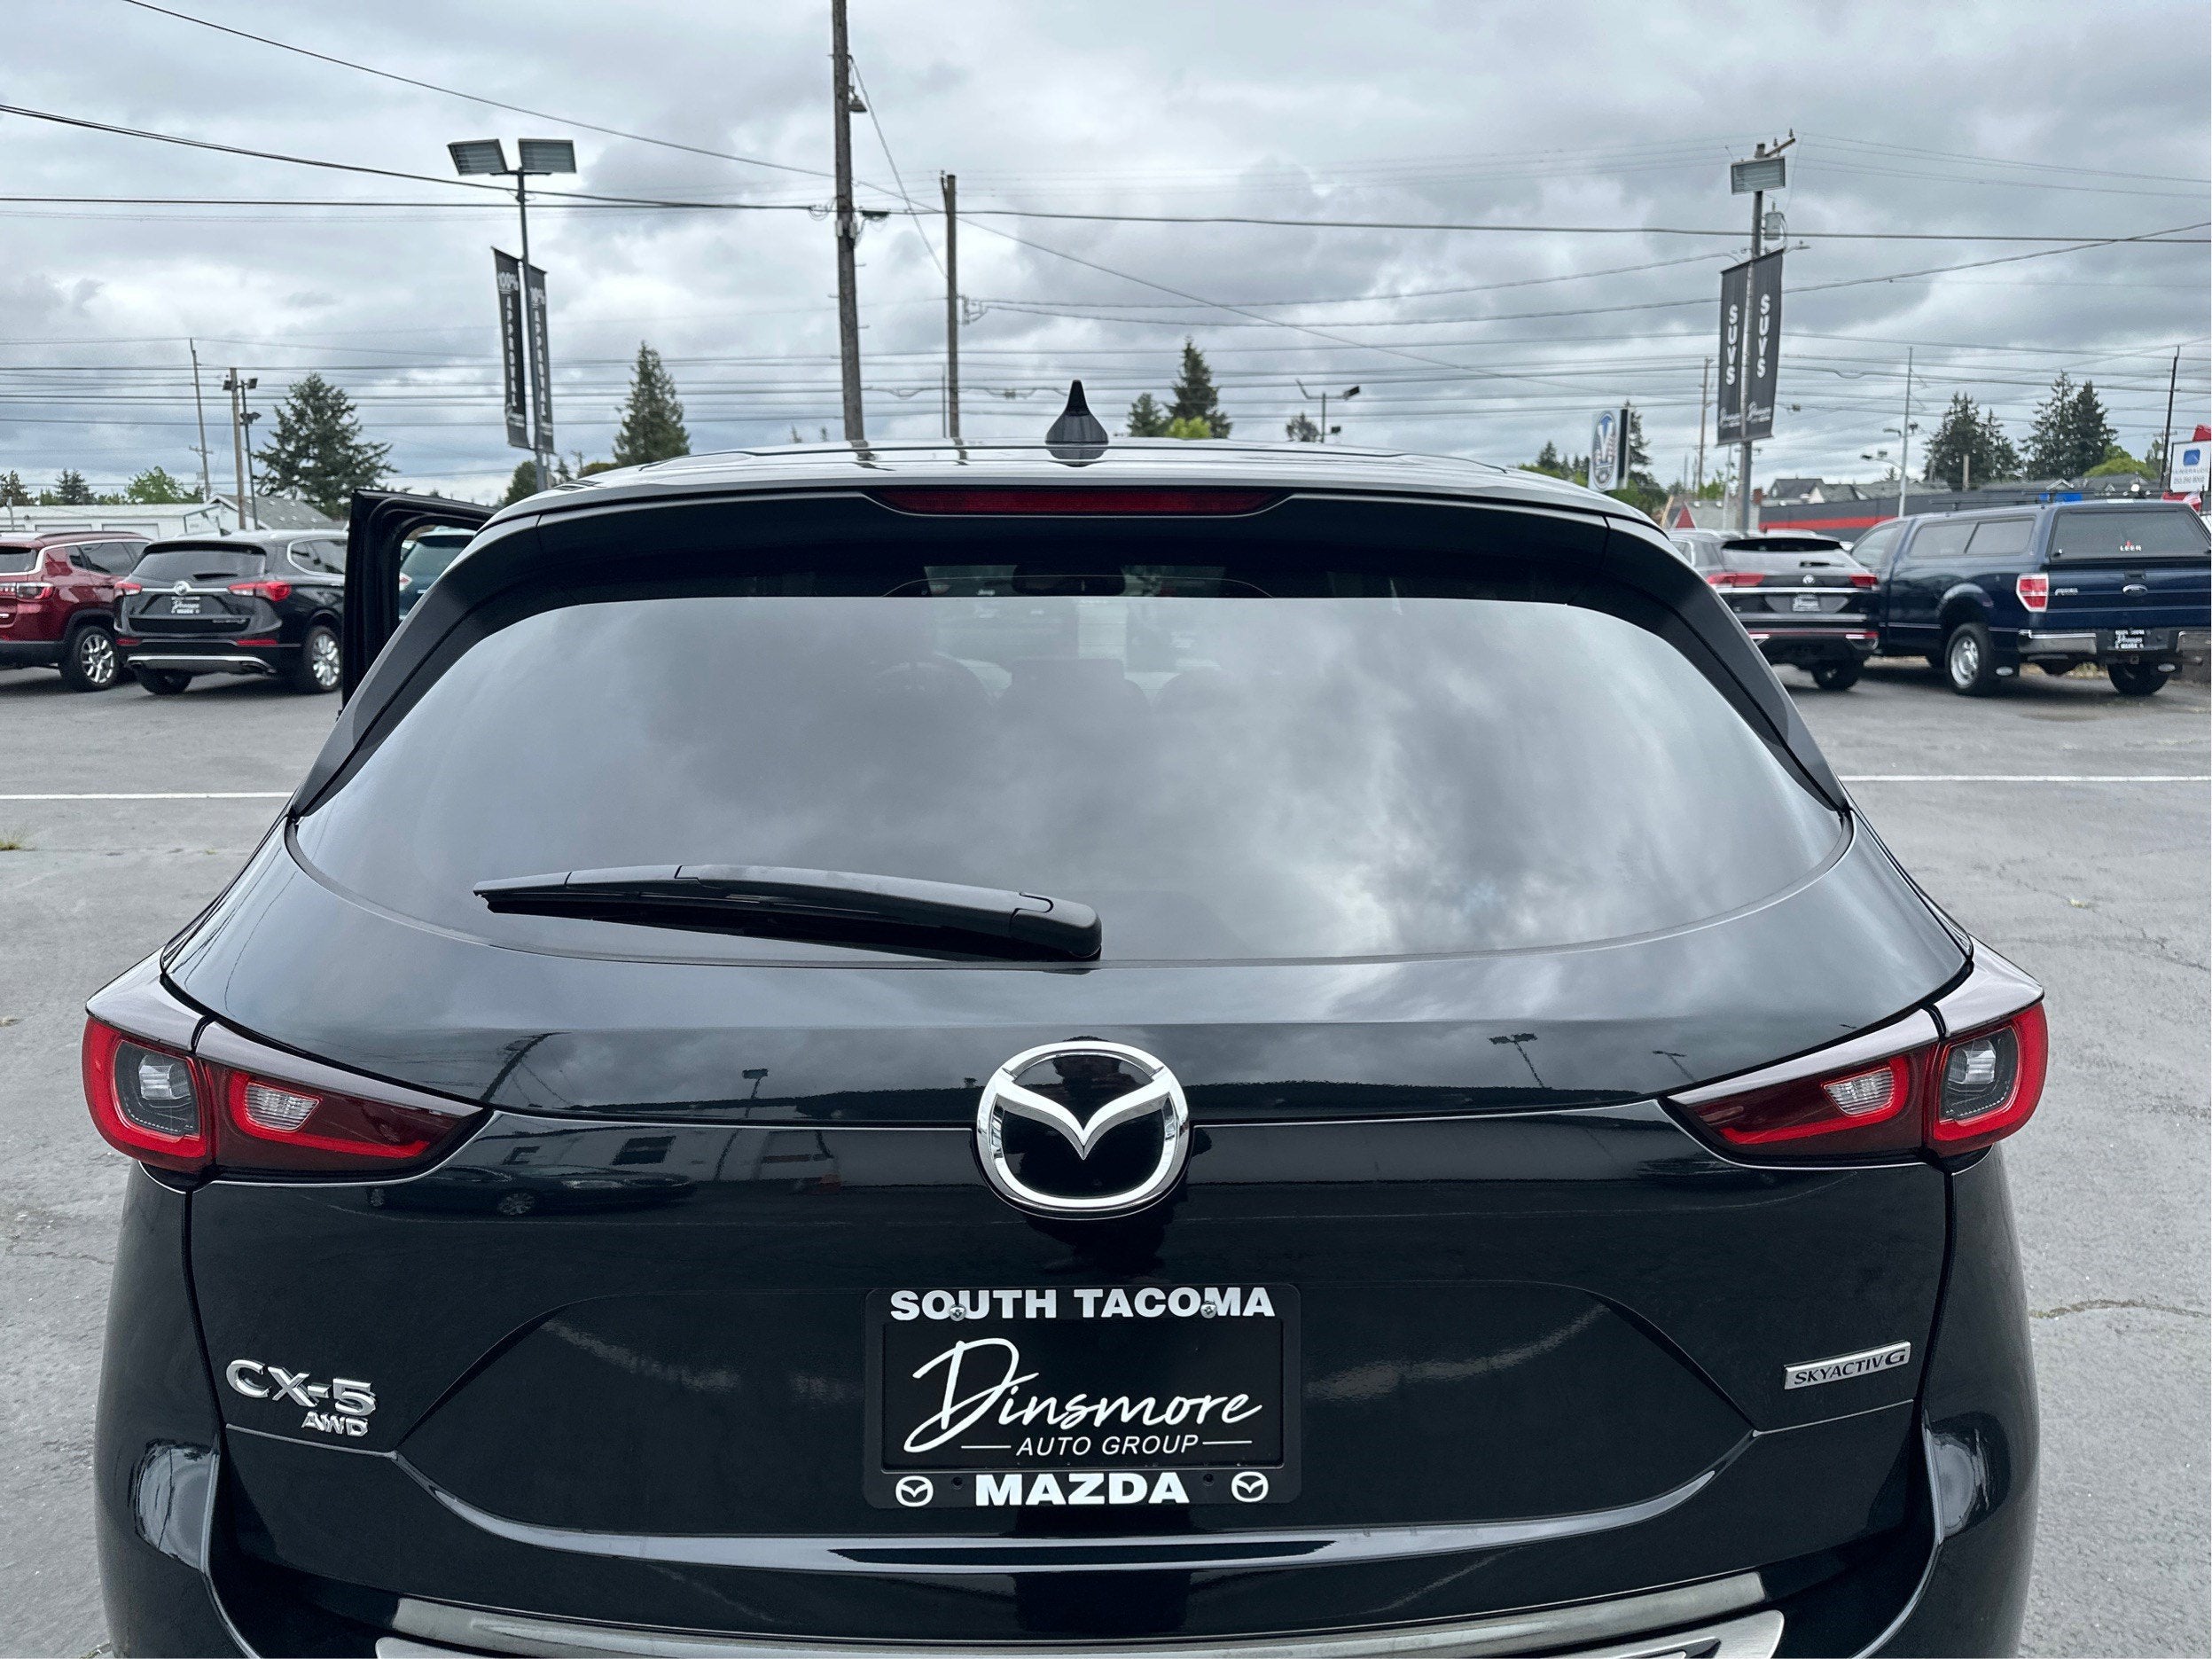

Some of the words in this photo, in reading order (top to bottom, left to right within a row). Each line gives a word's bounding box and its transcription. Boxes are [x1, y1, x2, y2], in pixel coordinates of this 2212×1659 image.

[1725, 304, 1739, 386] SUVS
[1756, 293, 1770, 379] SUVS
[890, 1290, 1057, 1321] SOUTH
[1074, 1287, 1276, 1319] TACOMA
[226, 1359, 377, 1416] CX-5
[903, 1337, 1262, 1453] Dinsmore
[301, 1411, 369, 1437] AWD
[1016, 1436, 1091, 1457] AUTO
[1101, 1434, 1199, 1455] GROUP
[975, 1472, 1190, 1506] MAZDA
